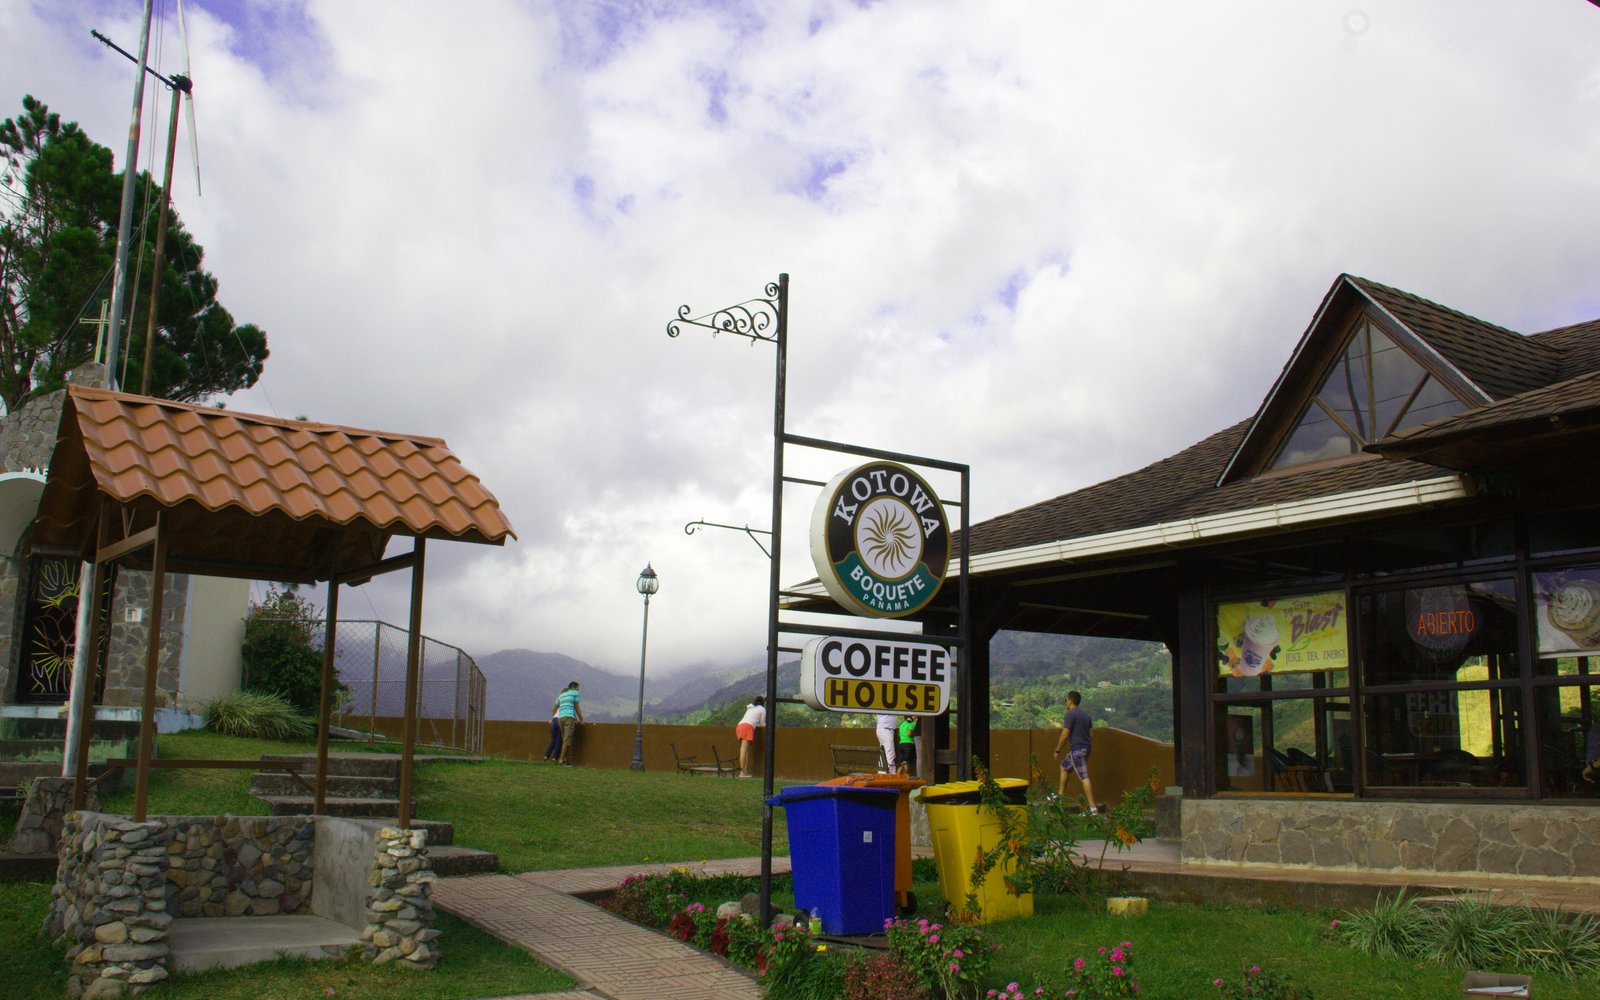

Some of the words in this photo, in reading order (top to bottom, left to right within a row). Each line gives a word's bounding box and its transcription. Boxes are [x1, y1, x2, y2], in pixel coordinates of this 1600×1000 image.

[834, 470, 940, 539] KOTOWA
[850, 565, 925, 601] BOQUETE
[862, 594, 910, 611] PANAMA
[1417, 610, 1476, 636] ABIERTO
[821, 641, 945, 682] COFFEE
[830, 680, 936, 711] HOUSE
